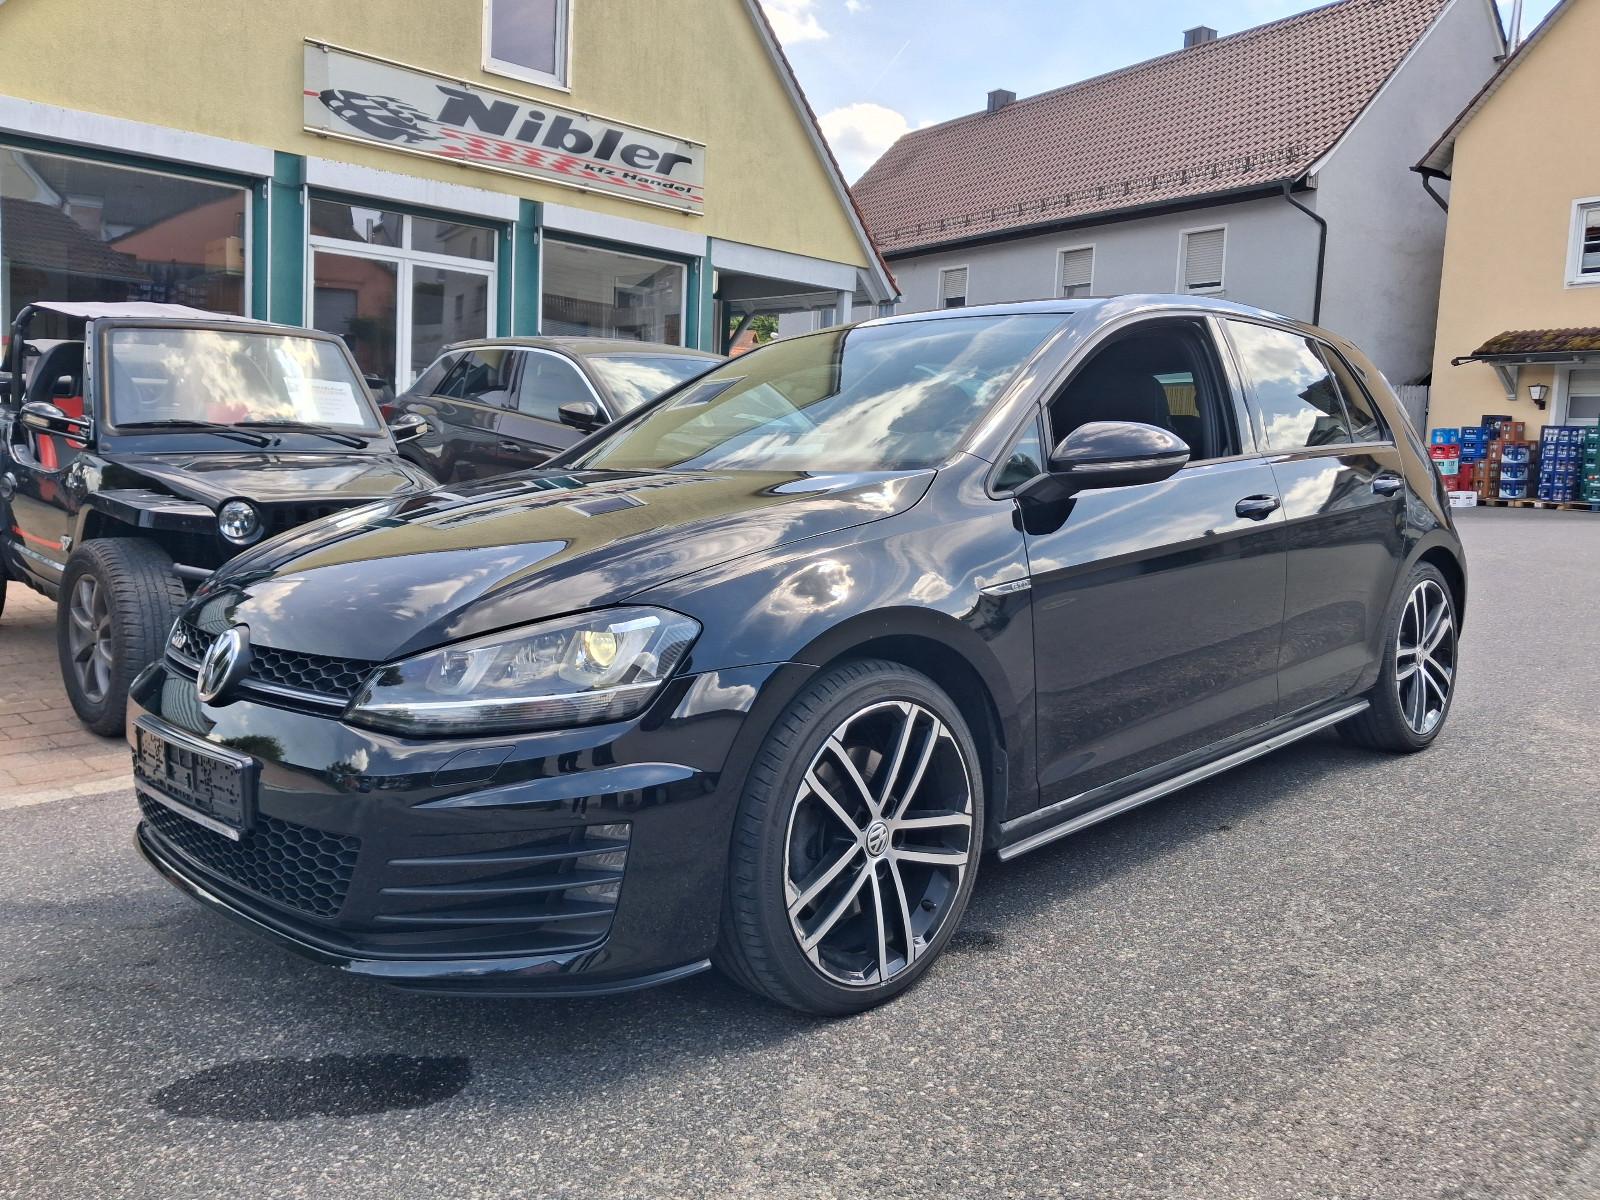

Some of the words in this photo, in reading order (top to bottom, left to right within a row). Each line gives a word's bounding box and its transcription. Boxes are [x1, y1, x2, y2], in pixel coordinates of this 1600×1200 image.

[436, 84, 692, 175] Nibler
[584, 163, 616, 176] kfz
[622, 172, 692, 193] Handel
